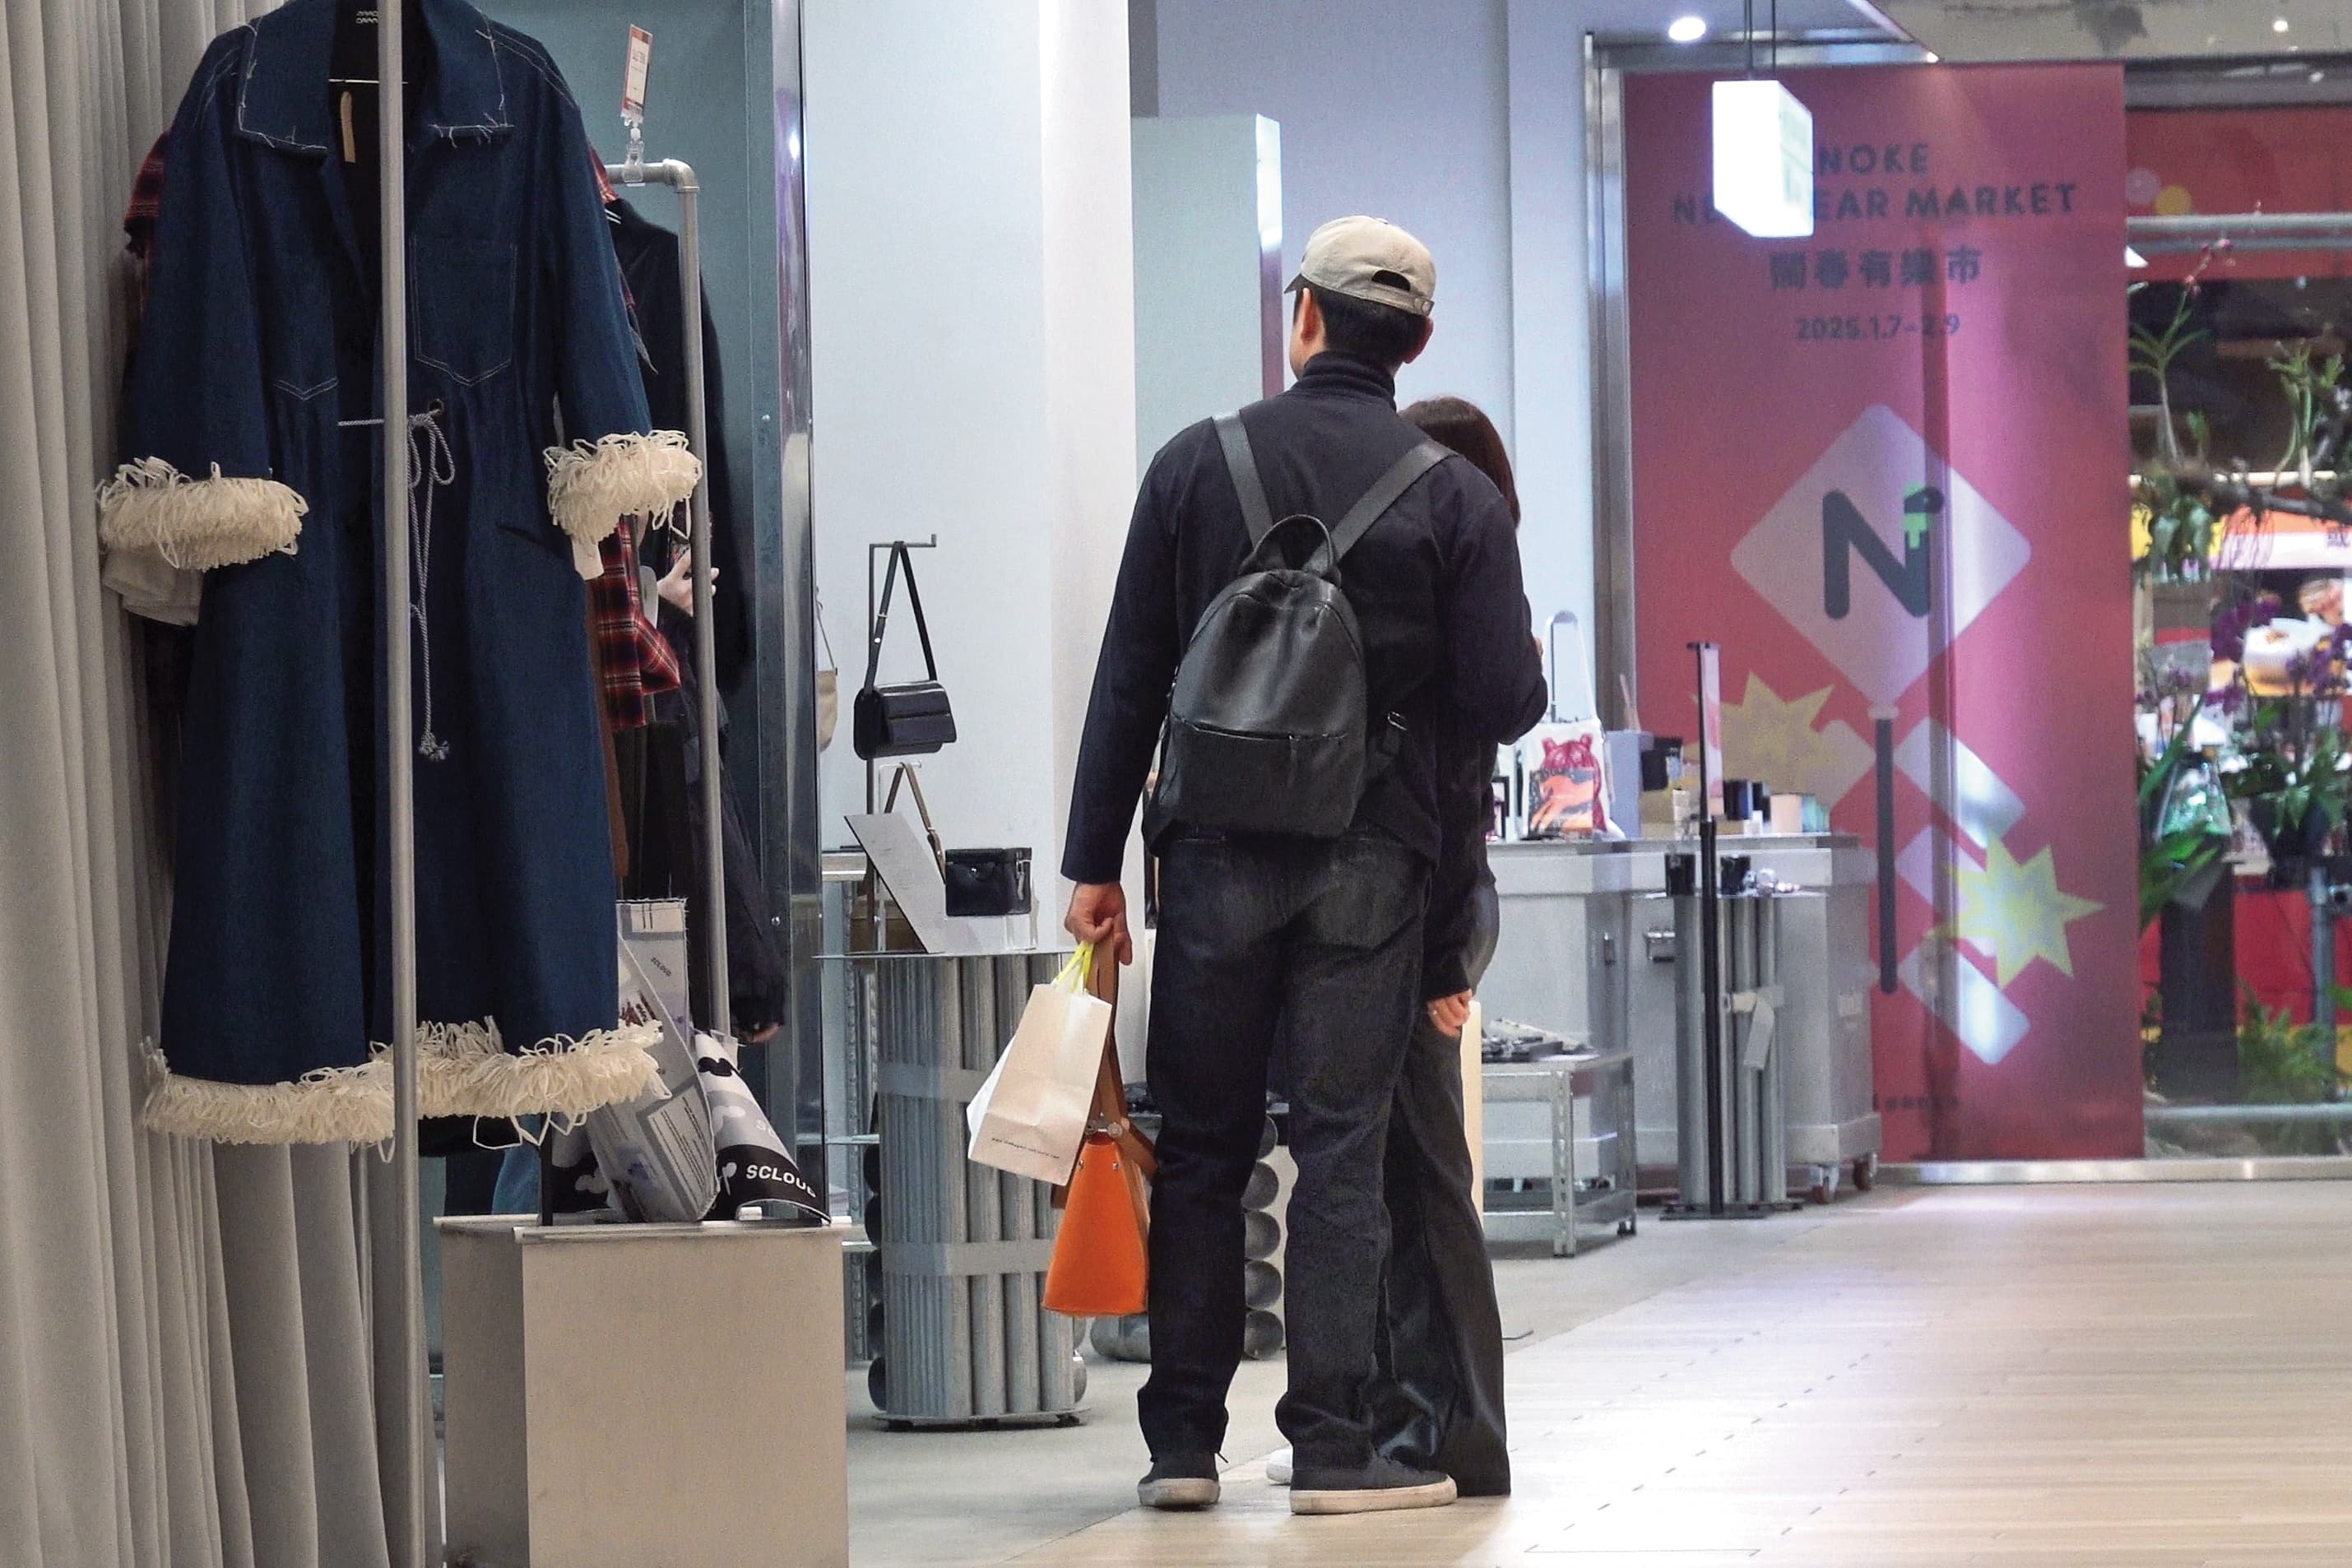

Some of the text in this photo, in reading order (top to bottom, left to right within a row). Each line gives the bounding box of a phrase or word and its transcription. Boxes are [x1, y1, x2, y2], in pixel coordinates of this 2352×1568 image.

[1818, 142, 1929, 174] NOKE
[1814, 188, 1889, 220] EAR
[1905, 183, 2076, 220] MARKET
